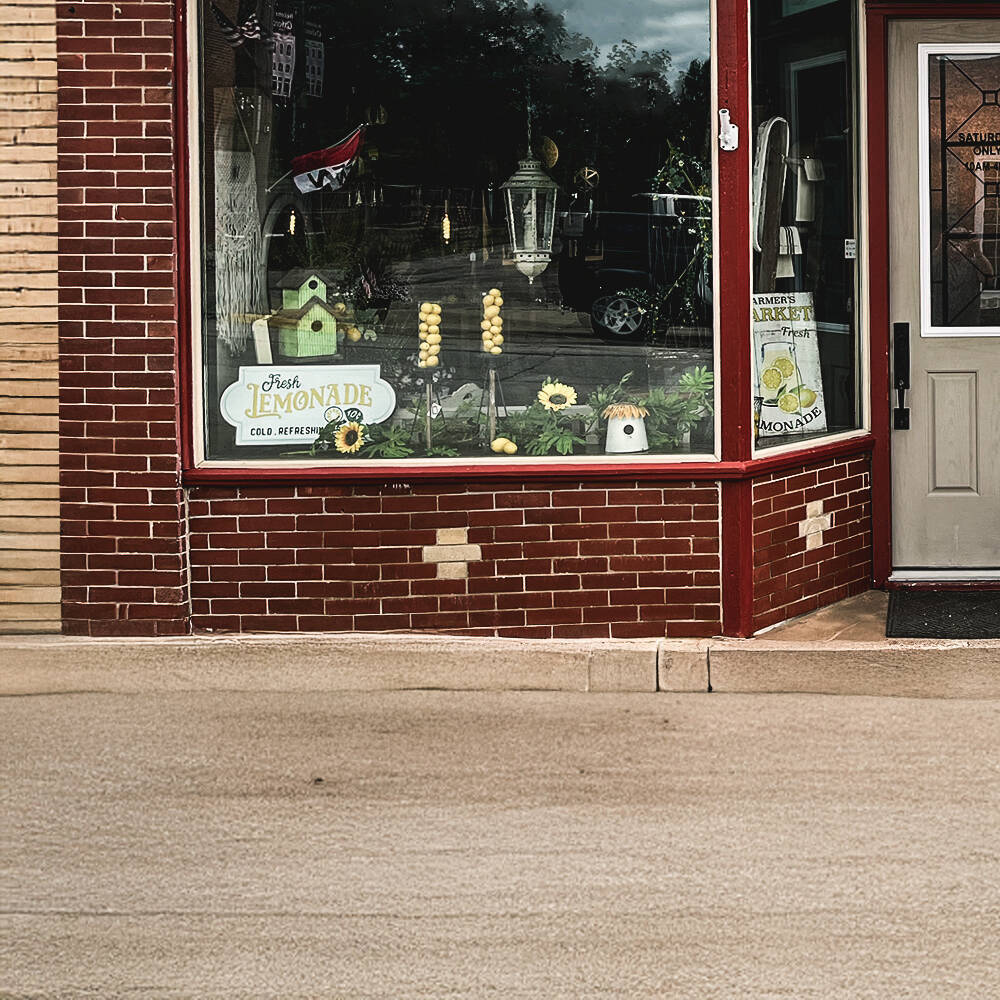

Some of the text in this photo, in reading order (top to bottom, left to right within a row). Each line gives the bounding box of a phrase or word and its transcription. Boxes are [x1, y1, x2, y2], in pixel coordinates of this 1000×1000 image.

[753, 296, 796, 305] ARMER'S
[753, 306, 812, 322] ARKET
[781, 326, 810, 338] Fresh
[261, 373, 302, 392] Fresh
[244, 383, 373, 419] LEMONADE
[760, 407, 822, 432] MONADE
